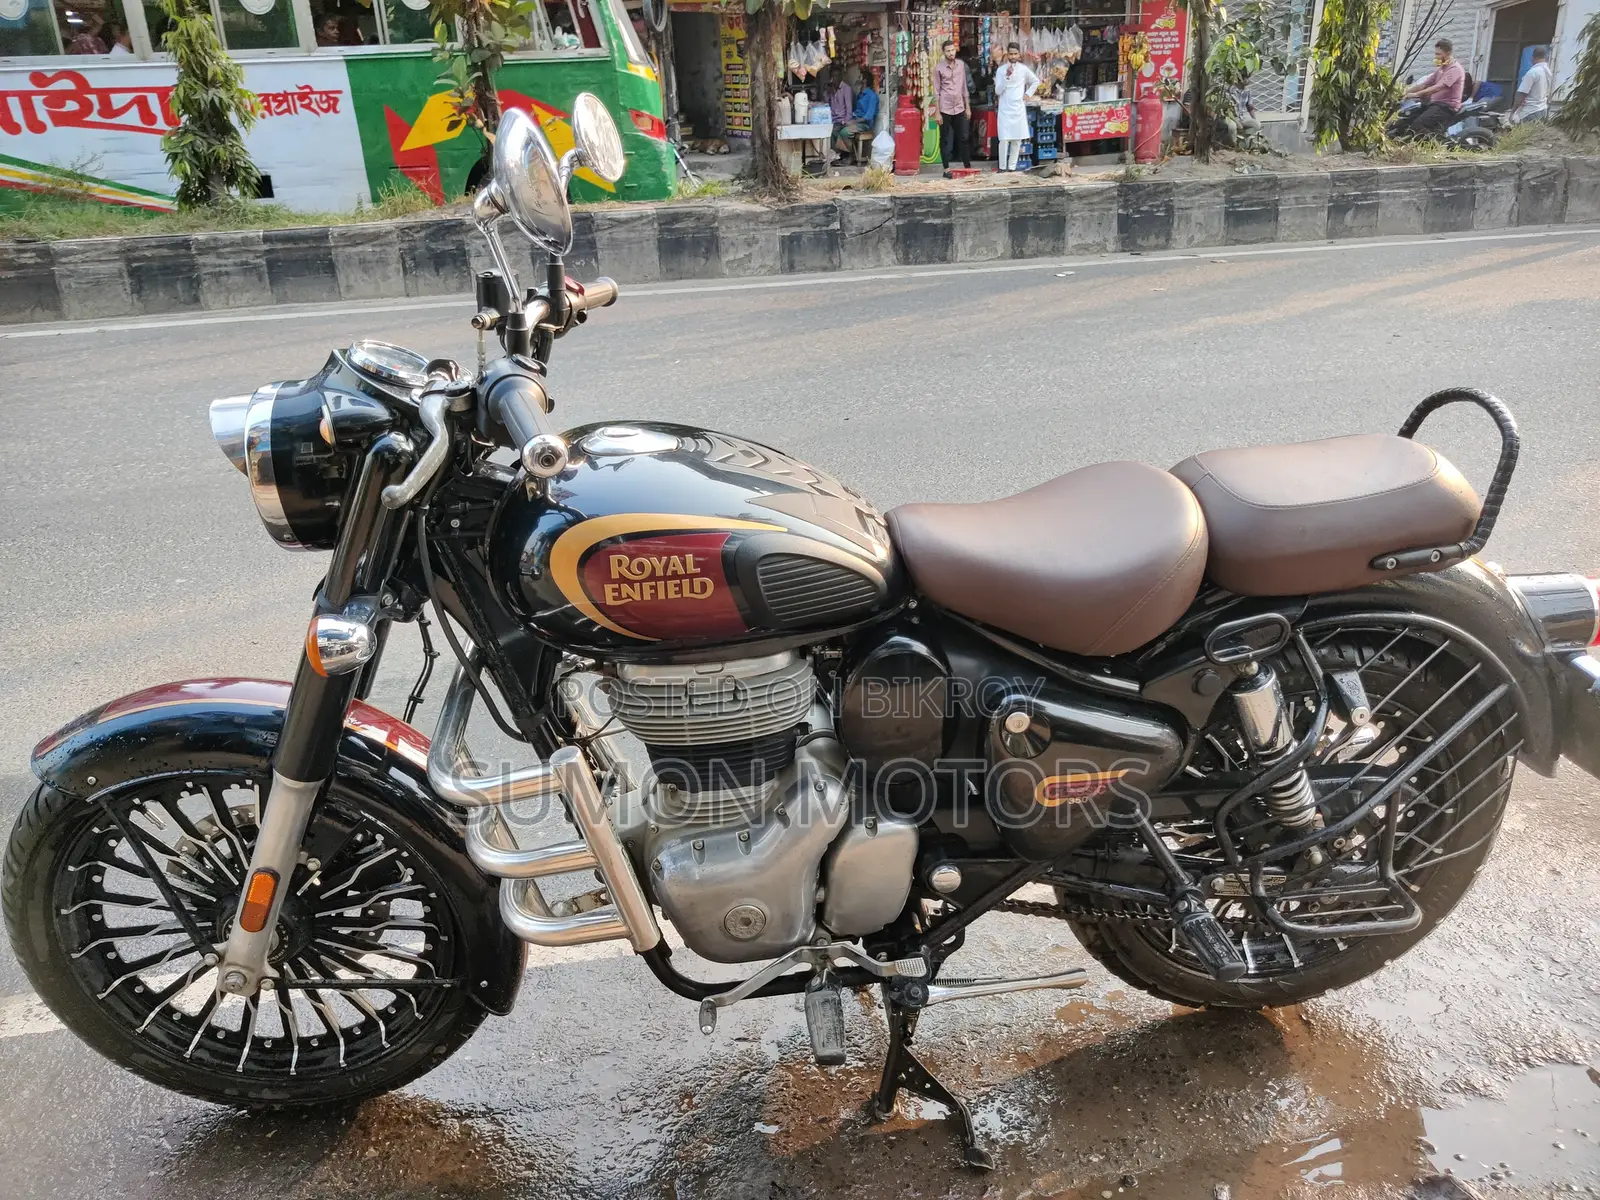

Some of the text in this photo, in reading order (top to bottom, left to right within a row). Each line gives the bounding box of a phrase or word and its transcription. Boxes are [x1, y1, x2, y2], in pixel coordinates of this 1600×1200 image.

[609, 554, 701, 580] ROYAL
[604, 577, 715, 606] ENFIELD
[1067, 796, 1089, 805] 350
